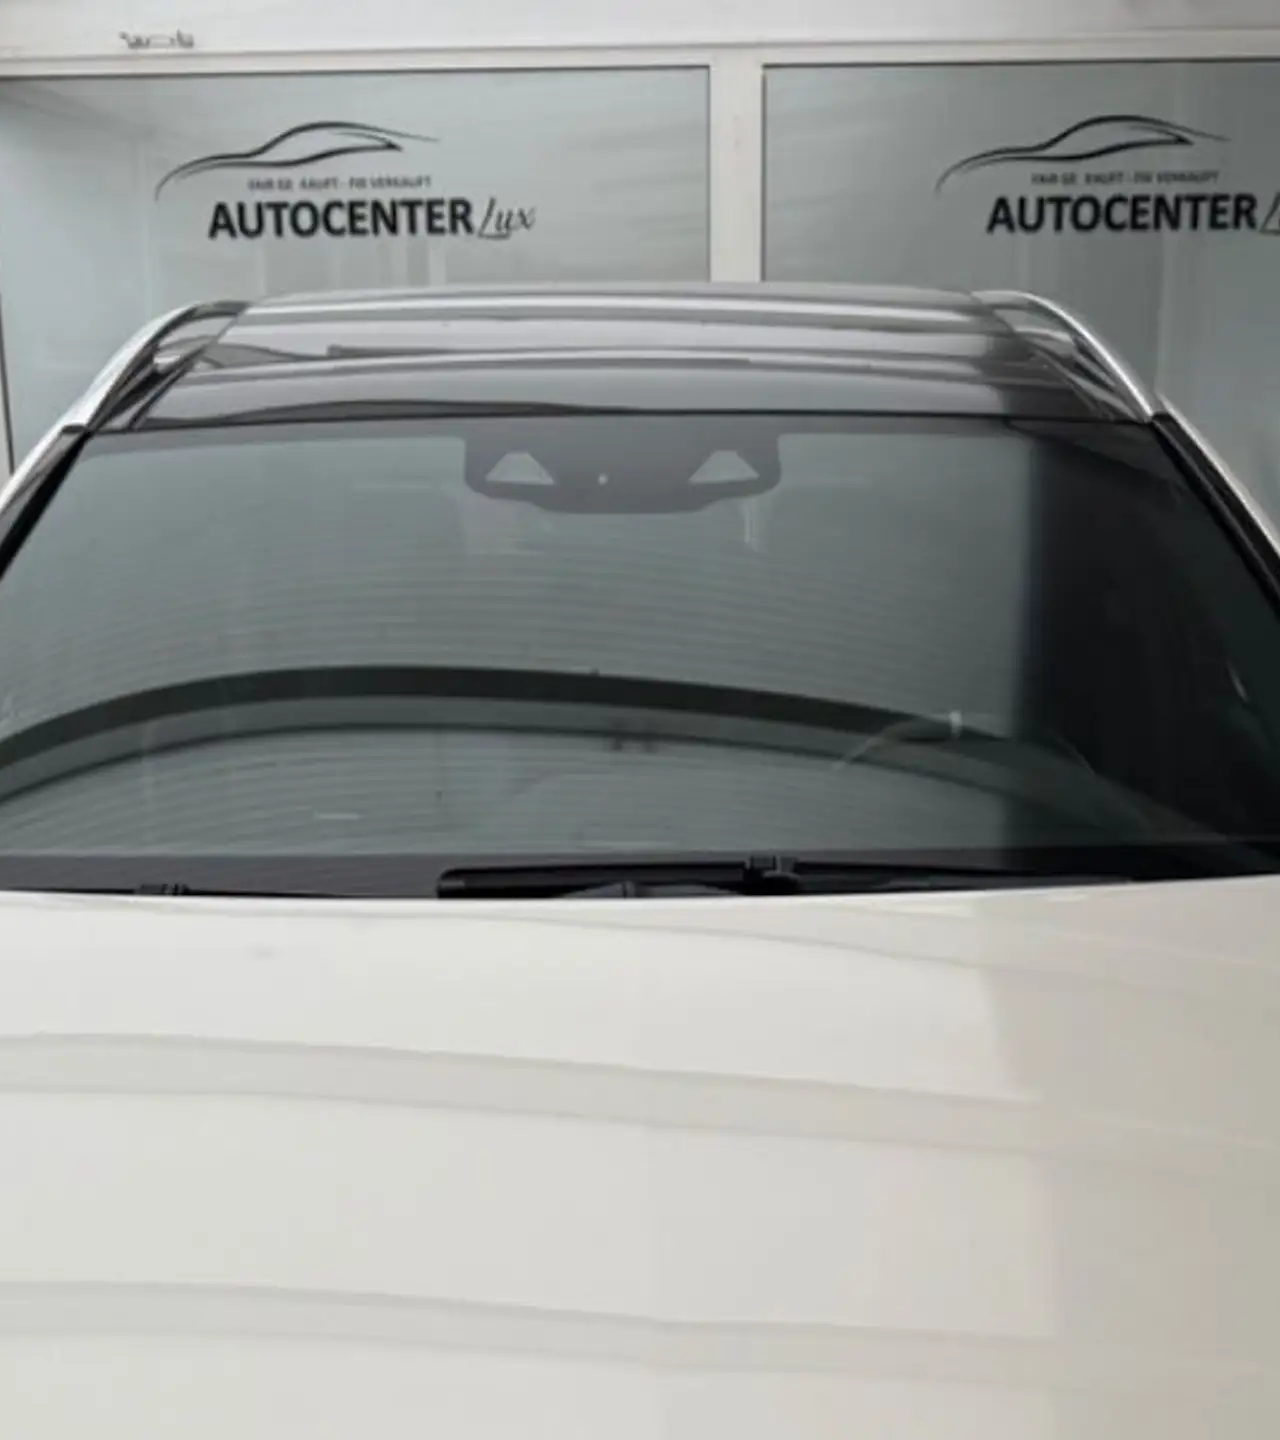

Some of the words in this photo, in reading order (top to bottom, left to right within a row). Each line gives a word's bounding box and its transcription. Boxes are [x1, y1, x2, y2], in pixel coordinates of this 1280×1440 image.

[207, 198, 474, 239] AUTOCENTER
[477, 198, 536, 239] Lux
[986, 193, 1259, 234] AUTOCENTER
